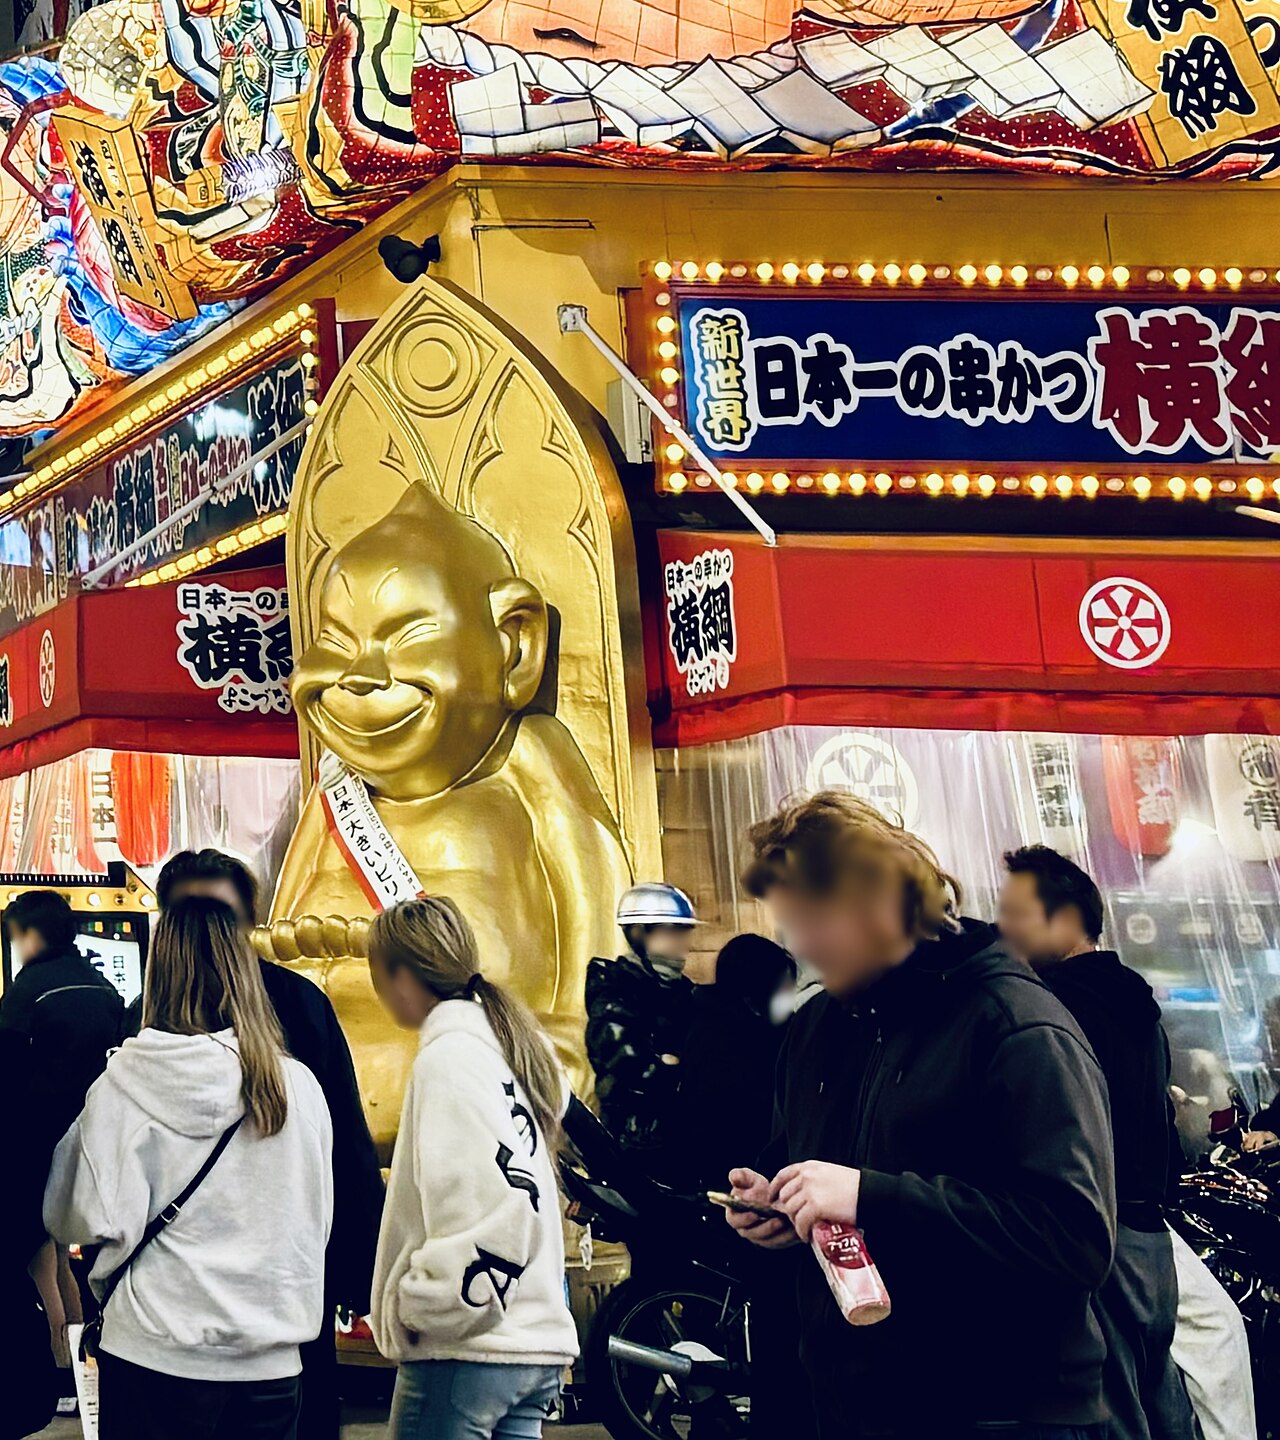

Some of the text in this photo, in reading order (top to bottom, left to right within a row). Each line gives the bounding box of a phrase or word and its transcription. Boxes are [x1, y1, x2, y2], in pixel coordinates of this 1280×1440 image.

[695, 311, 750, 447] 新世界
[752, 336, 1091, 423] 日本一の串かつ
[666, 553, 733, 592] 日本一の串かつ
[669, 579, 736, 668] 横綱
[332, 785, 408, 902] 日本一大きいビリ
